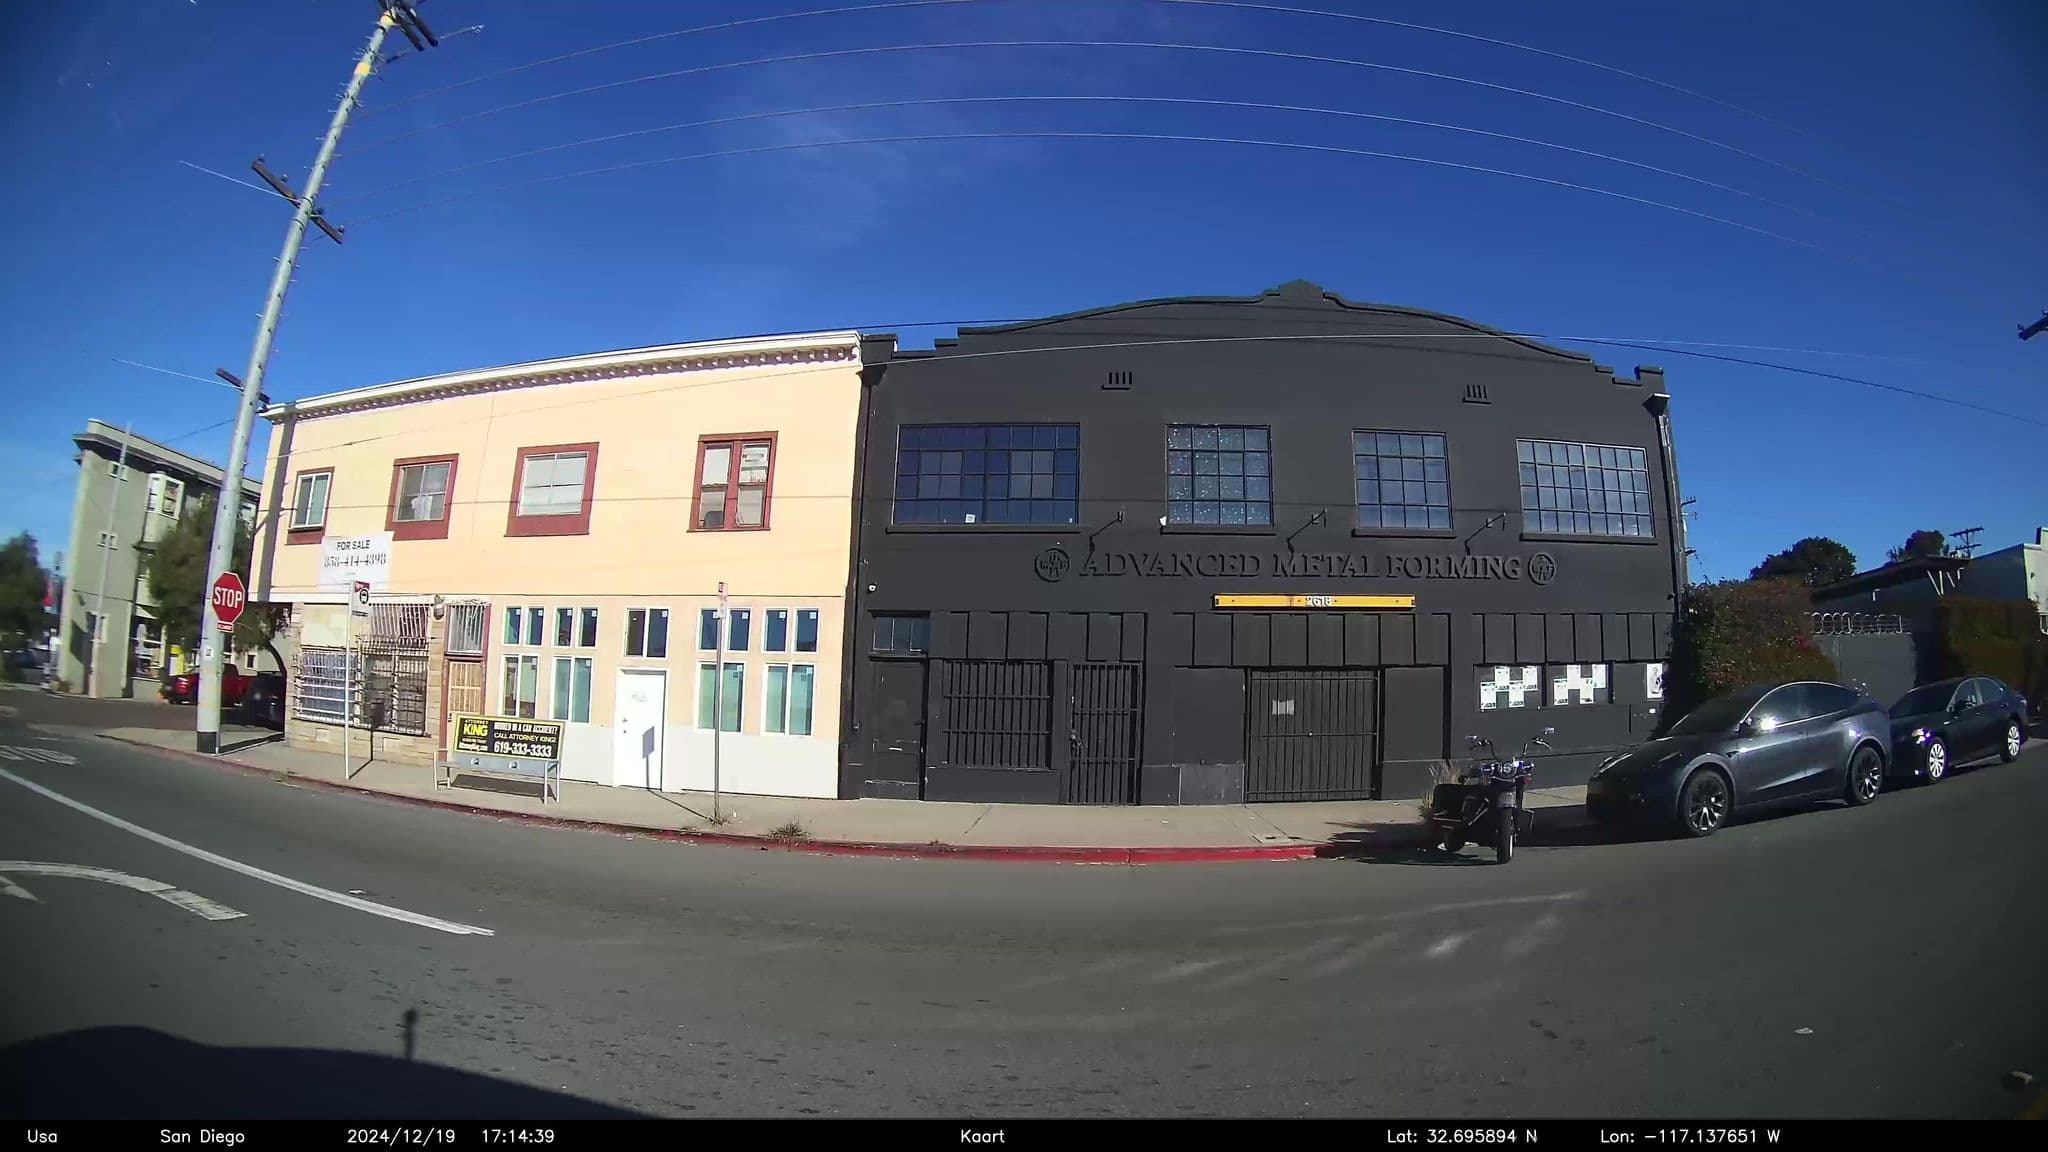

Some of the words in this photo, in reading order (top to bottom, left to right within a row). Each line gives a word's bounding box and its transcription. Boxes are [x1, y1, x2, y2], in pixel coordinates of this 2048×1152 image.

[336, 541, 351, 551] FOR
[352, 539, 371, 550] SALE
[1079, 552, 1260, 578] ADVANCED
[1272, 553, 1380, 578] METAL
[1386, 554, 1520, 580] FORMING
[213, 586, 243, 609] STOP
[1305, 595, 1332, 608] 2618
[463, 724, 488, 737] KING
[493, 731, 508, 739] CALL
[508, 732, 539, 741] ATTORNEY
[494, 741, 552, 757] 619-333-3333
